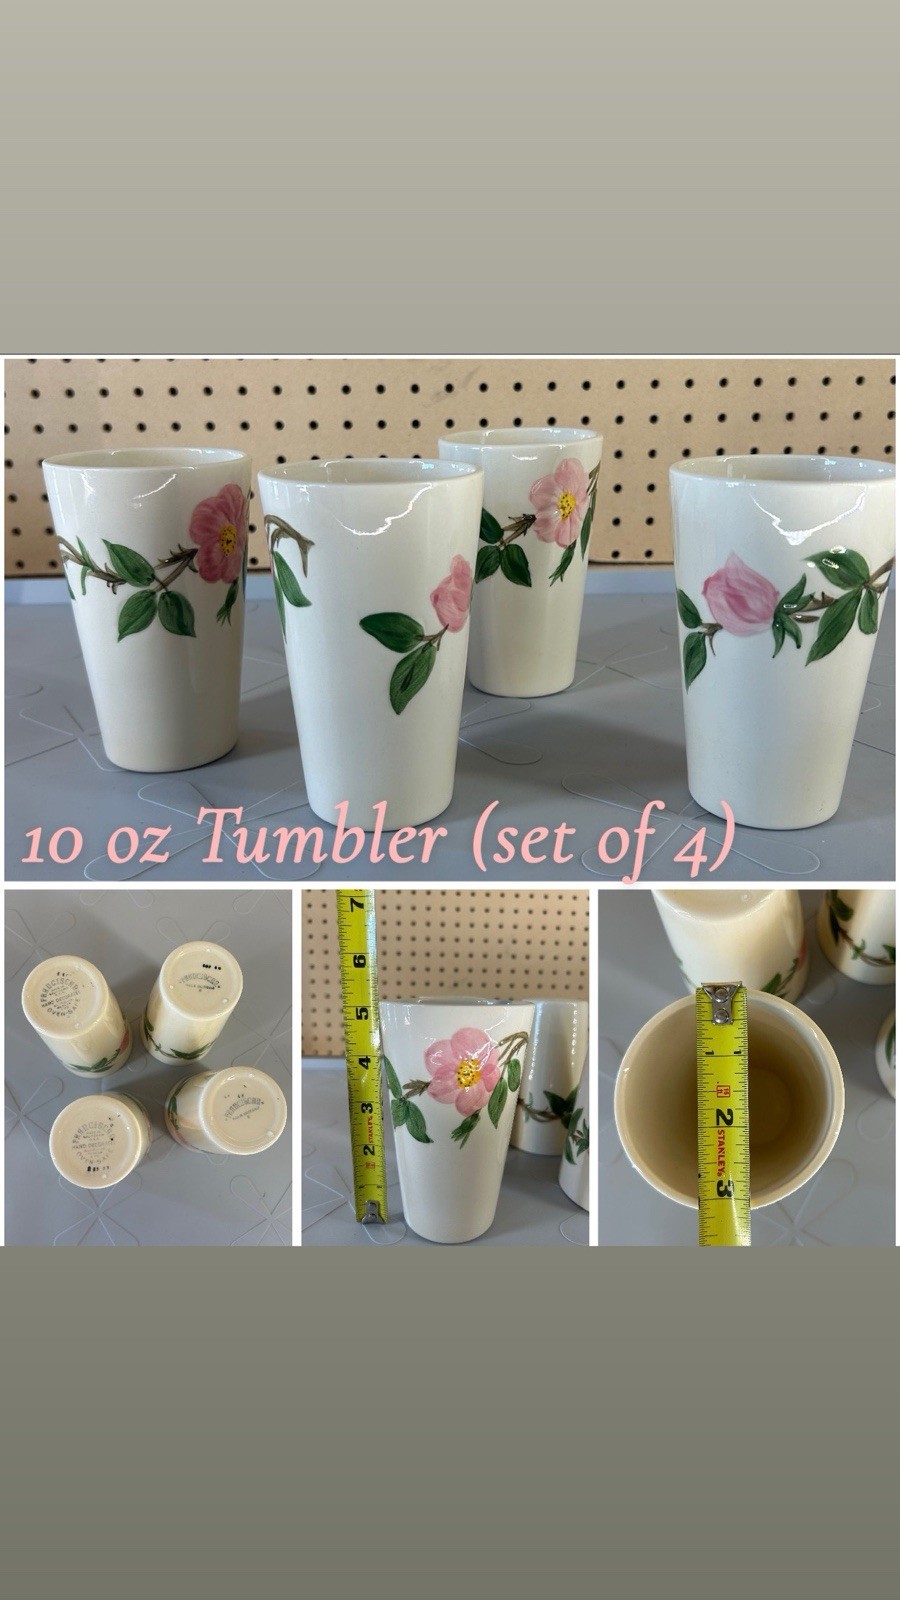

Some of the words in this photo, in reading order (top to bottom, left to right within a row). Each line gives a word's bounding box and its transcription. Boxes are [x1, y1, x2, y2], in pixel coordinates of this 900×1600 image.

[350, 897, 364, 912] 7
[353, 954, 366, 968] 6
[355, 1007, 369, 1020] 5
[358, 1056, 372, 1070] 4
[361, 1102, 373, 1114] 3
[716, 1108, 734, 1126] 2
[363, 1144, 375, 1156] 2
[716, 1180, 734, 1198] 3
